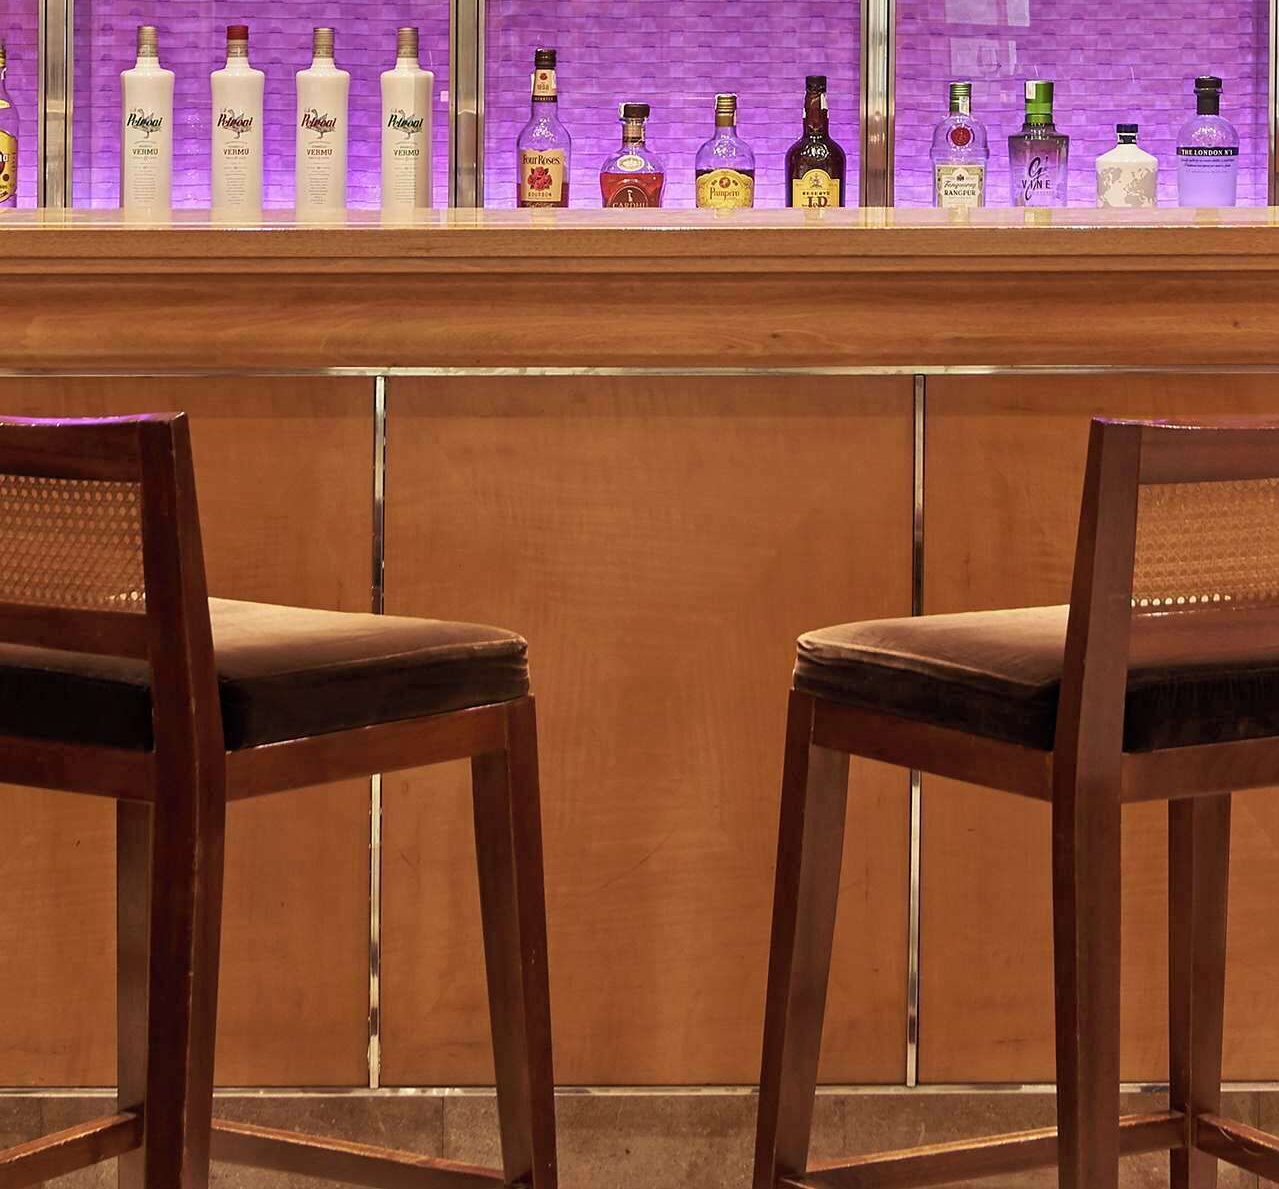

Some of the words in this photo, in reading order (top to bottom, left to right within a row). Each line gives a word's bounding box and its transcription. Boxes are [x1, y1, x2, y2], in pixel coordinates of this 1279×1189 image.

[522, 154, 538, 165] Four
[538, 154, 561, 165] Roses
[1022, 179, 1051, 189] VINE
[710, 187, 740, 201] Pampero
